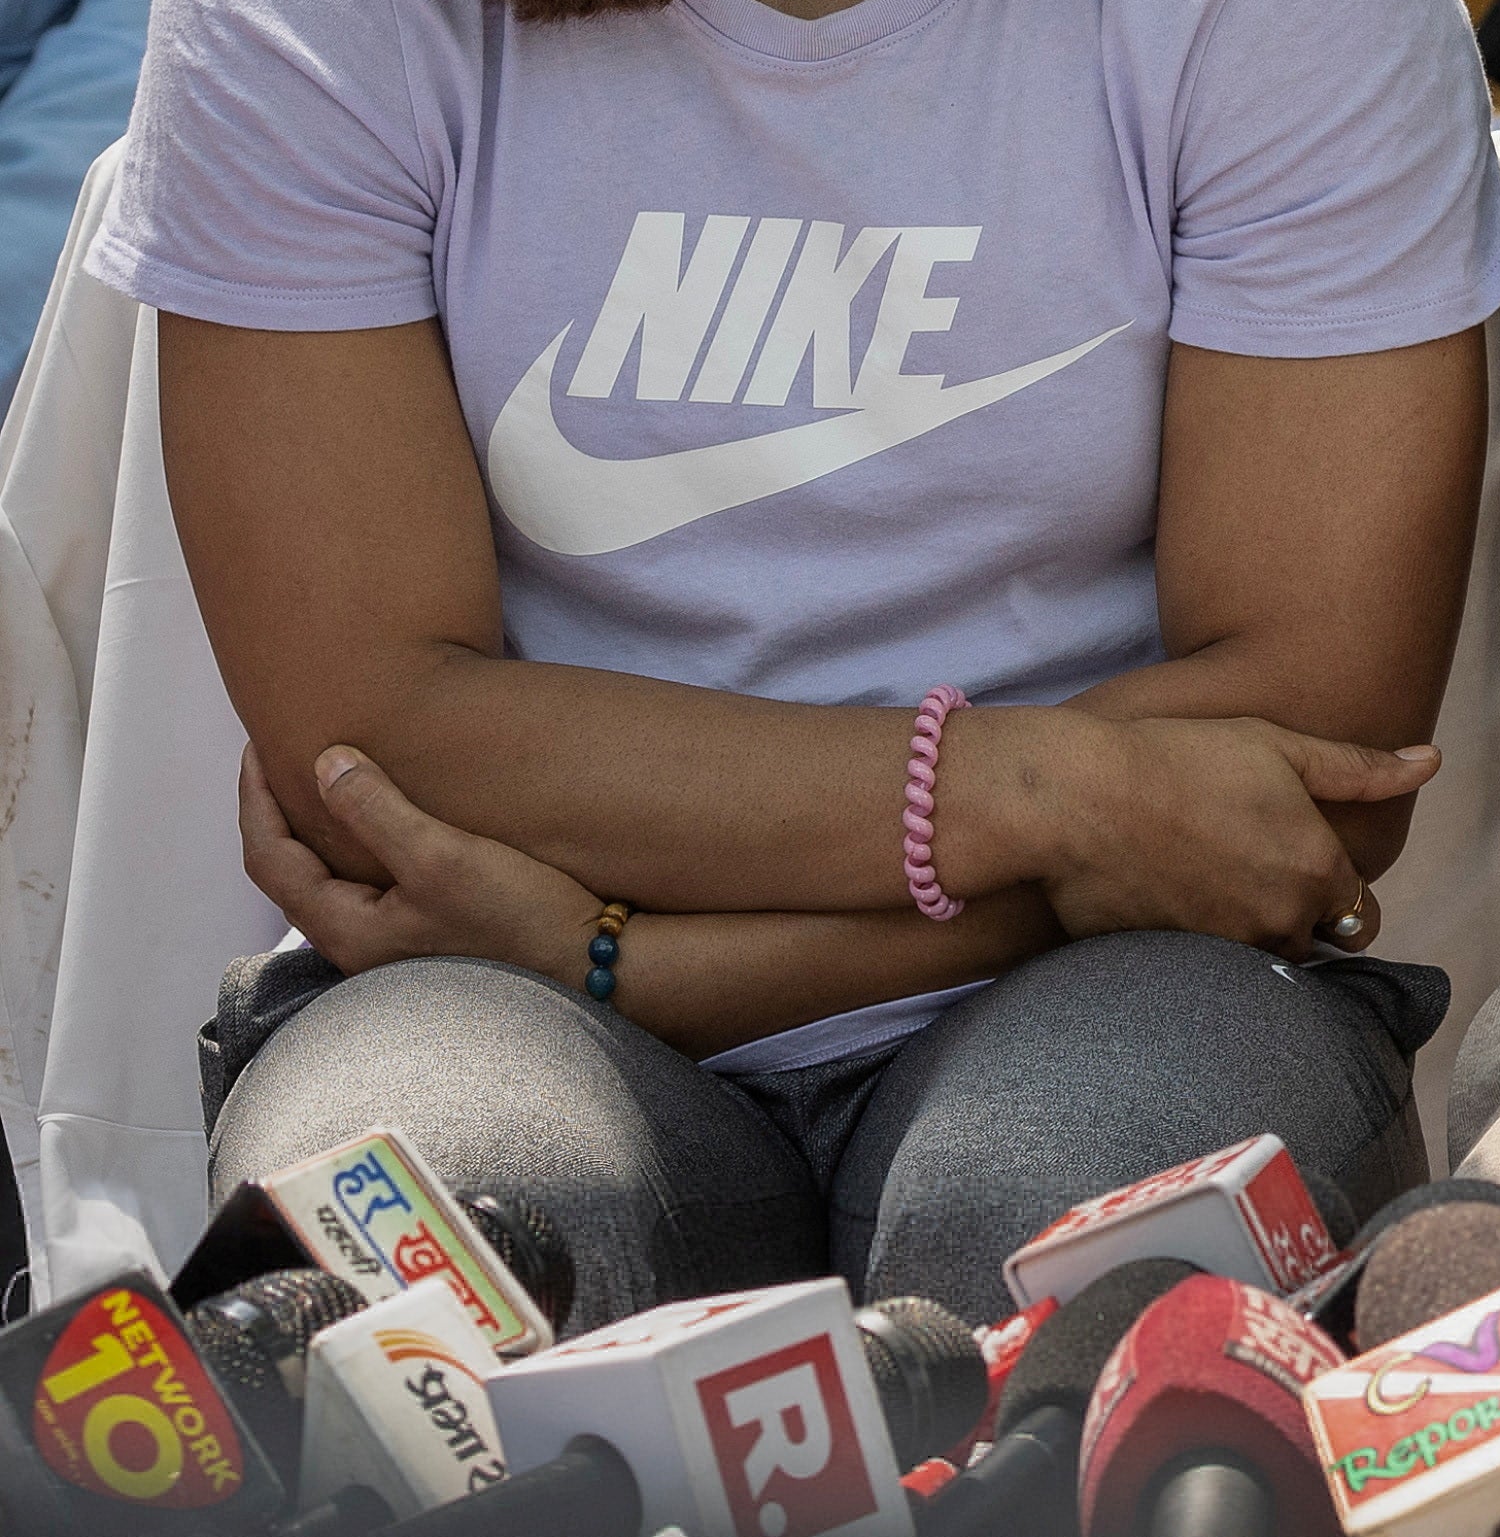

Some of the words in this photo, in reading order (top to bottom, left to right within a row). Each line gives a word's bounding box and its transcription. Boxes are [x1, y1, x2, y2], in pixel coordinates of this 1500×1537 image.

[566, 211, 983, 410] NIKE
[43, 1332, 184, 1499] 10
[102, 1289, 241, 1493] NETWORK
